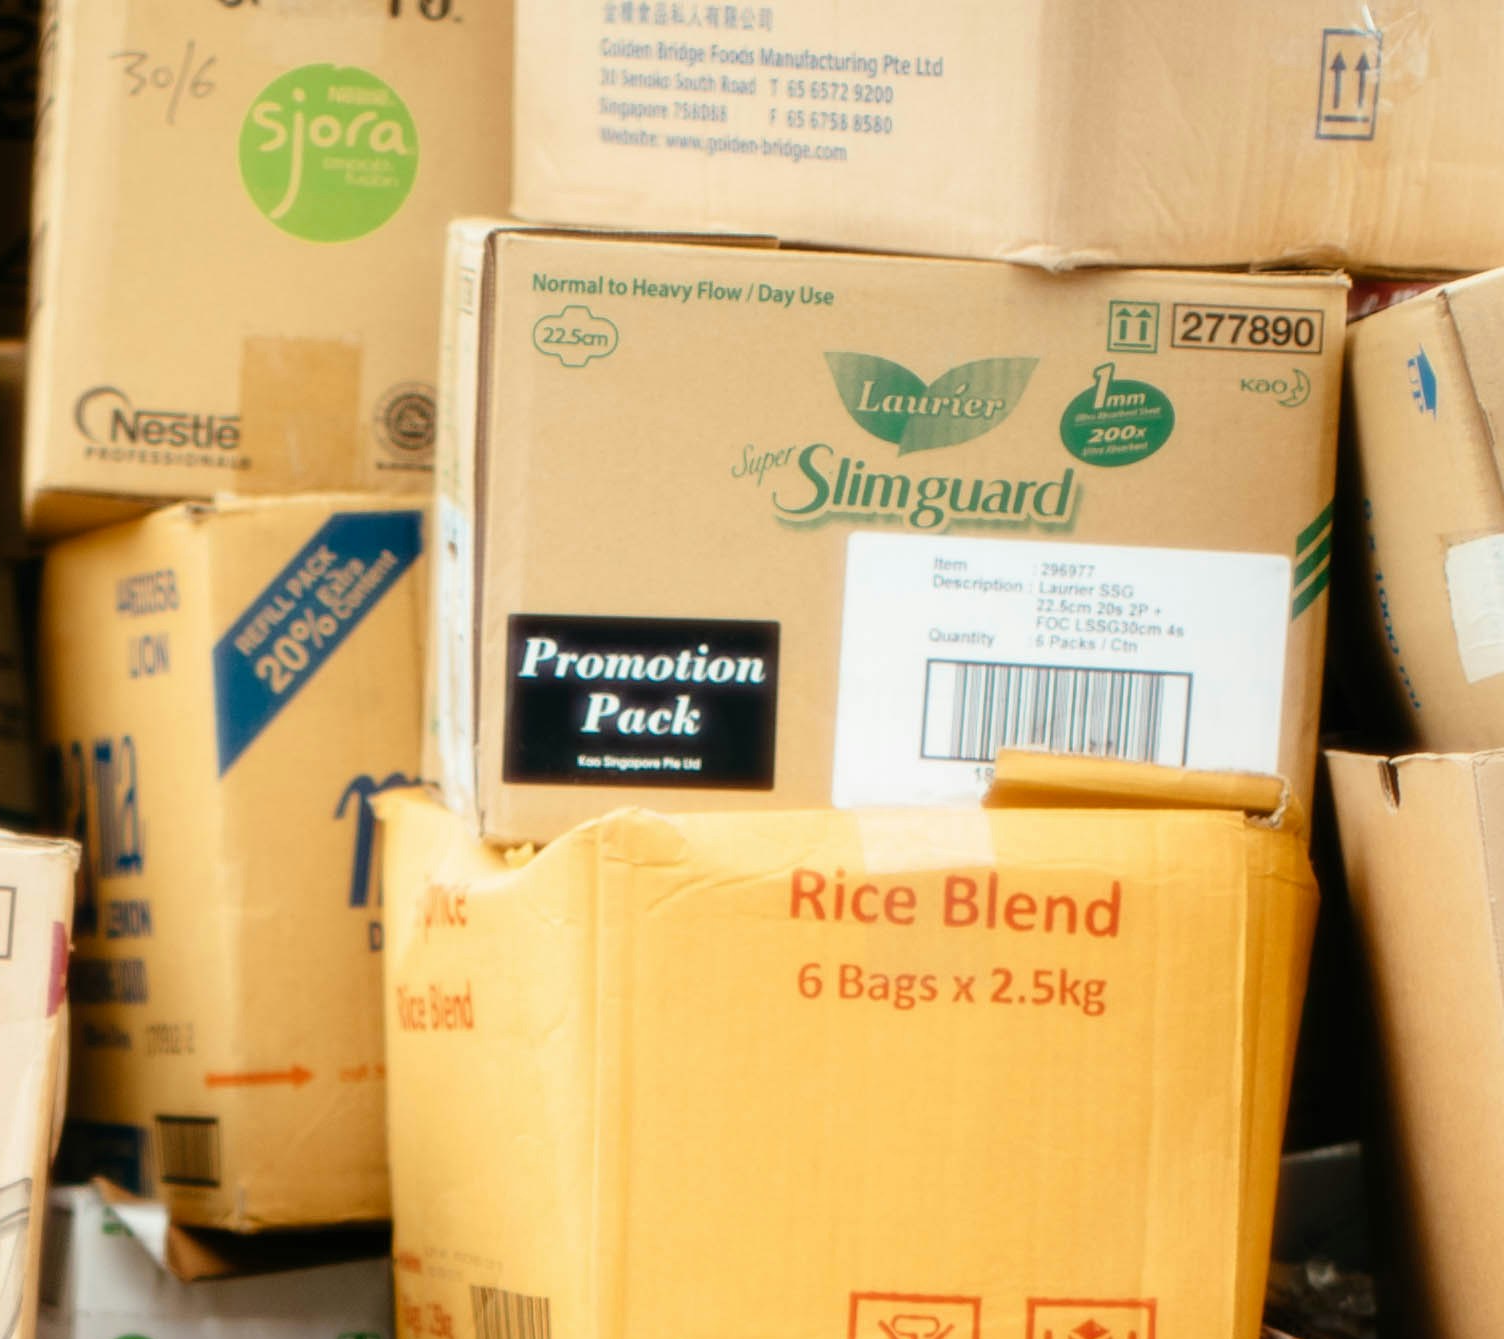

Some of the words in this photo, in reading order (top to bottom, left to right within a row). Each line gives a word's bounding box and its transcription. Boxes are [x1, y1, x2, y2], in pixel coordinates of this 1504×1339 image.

[760, 48, 877, 76] Manufacturing
[882, 55, 910, 74] Pte
[916, 56, 944, 77] Ltd
[531, 272, 604, 298] Normal
[632, 277, 692, 305] Heavy
[696, 280, 744, 302] Flow
[757, 283, 793, 309] Day
[798, 285, 835, 306] Use
[541, 326, 610, 348] 22.5cm
[1178, 310, 1317, 348] 277890
[855, 379, 1004, 423] Laurier
[773, 442, 1081, 528] Slimguard
[932, 573, 1024, 595] Description
[517, 636, 768, 689] Promotion
[579, 688, 703, 740] Pack
[788, 868, 918, 929] Rice
[940, 875, 1123, 939] Blend
[796, 964, 824, 1000] 6
[837, 964, 938, 1010] Bags
[989, 969, 1109, 1017] 2.5kg
